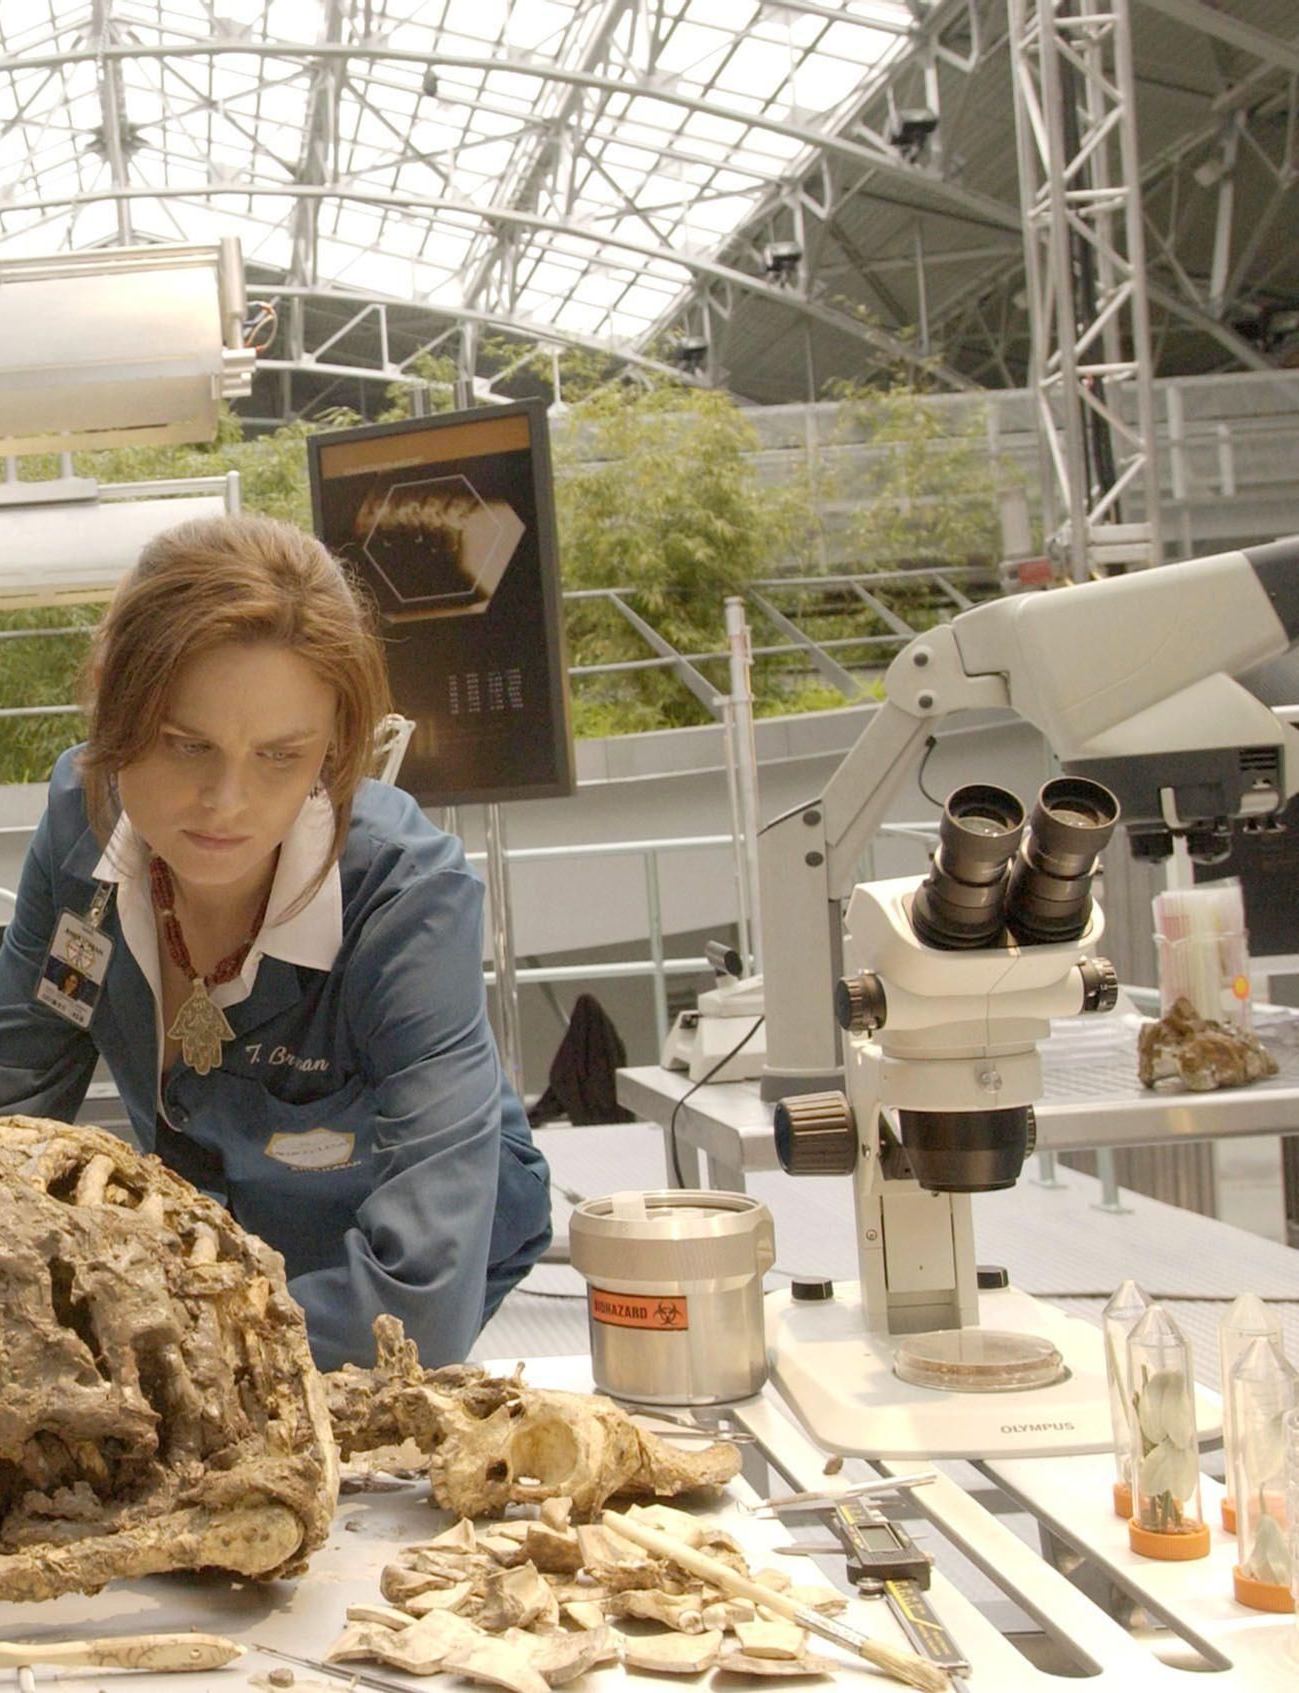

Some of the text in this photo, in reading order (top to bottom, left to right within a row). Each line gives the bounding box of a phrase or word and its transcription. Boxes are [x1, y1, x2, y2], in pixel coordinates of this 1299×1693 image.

[245, 1043, 262, 1065] T.
[594, 1299, 648, 1319] BIOHAZARD
[1000, 1422, 1075, 1434] OLYMPUS
